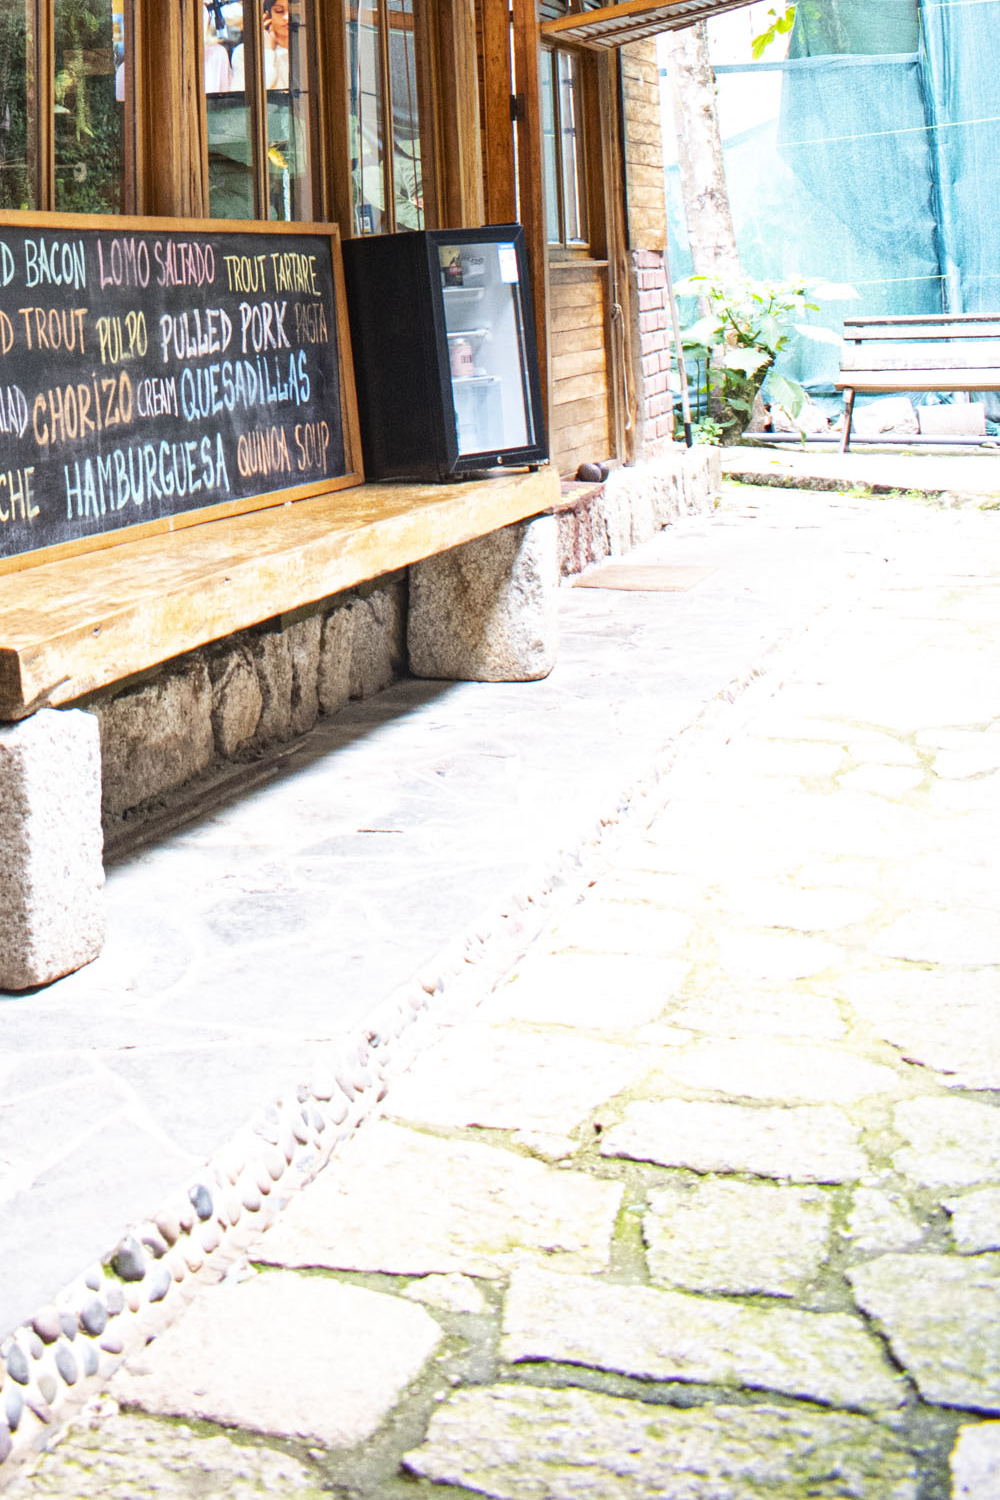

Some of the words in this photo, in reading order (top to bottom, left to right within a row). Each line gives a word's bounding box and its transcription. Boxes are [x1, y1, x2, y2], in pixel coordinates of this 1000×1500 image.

[25, 238, 86, 289] BACON
[97, 238, 150, 290] LOMO
[155, 238, 215, 287] SALTADO
[224, 255, 267, 294] TROUT
[271, 252, 321, 297] TARTARE
[19, 307, 88, 354] TROUT
[96, 311, 148, 364] PULPO
[159, 307, 232, 363] PULLED
[239, 301, 291, 354] PORK
[295, 303, 328, 344] PASTA
[137, 377, 178, 418] CREAM
[296, 422, 330, 475] SOUP
[64, 433, 230, 520] HAMBURGUESA
